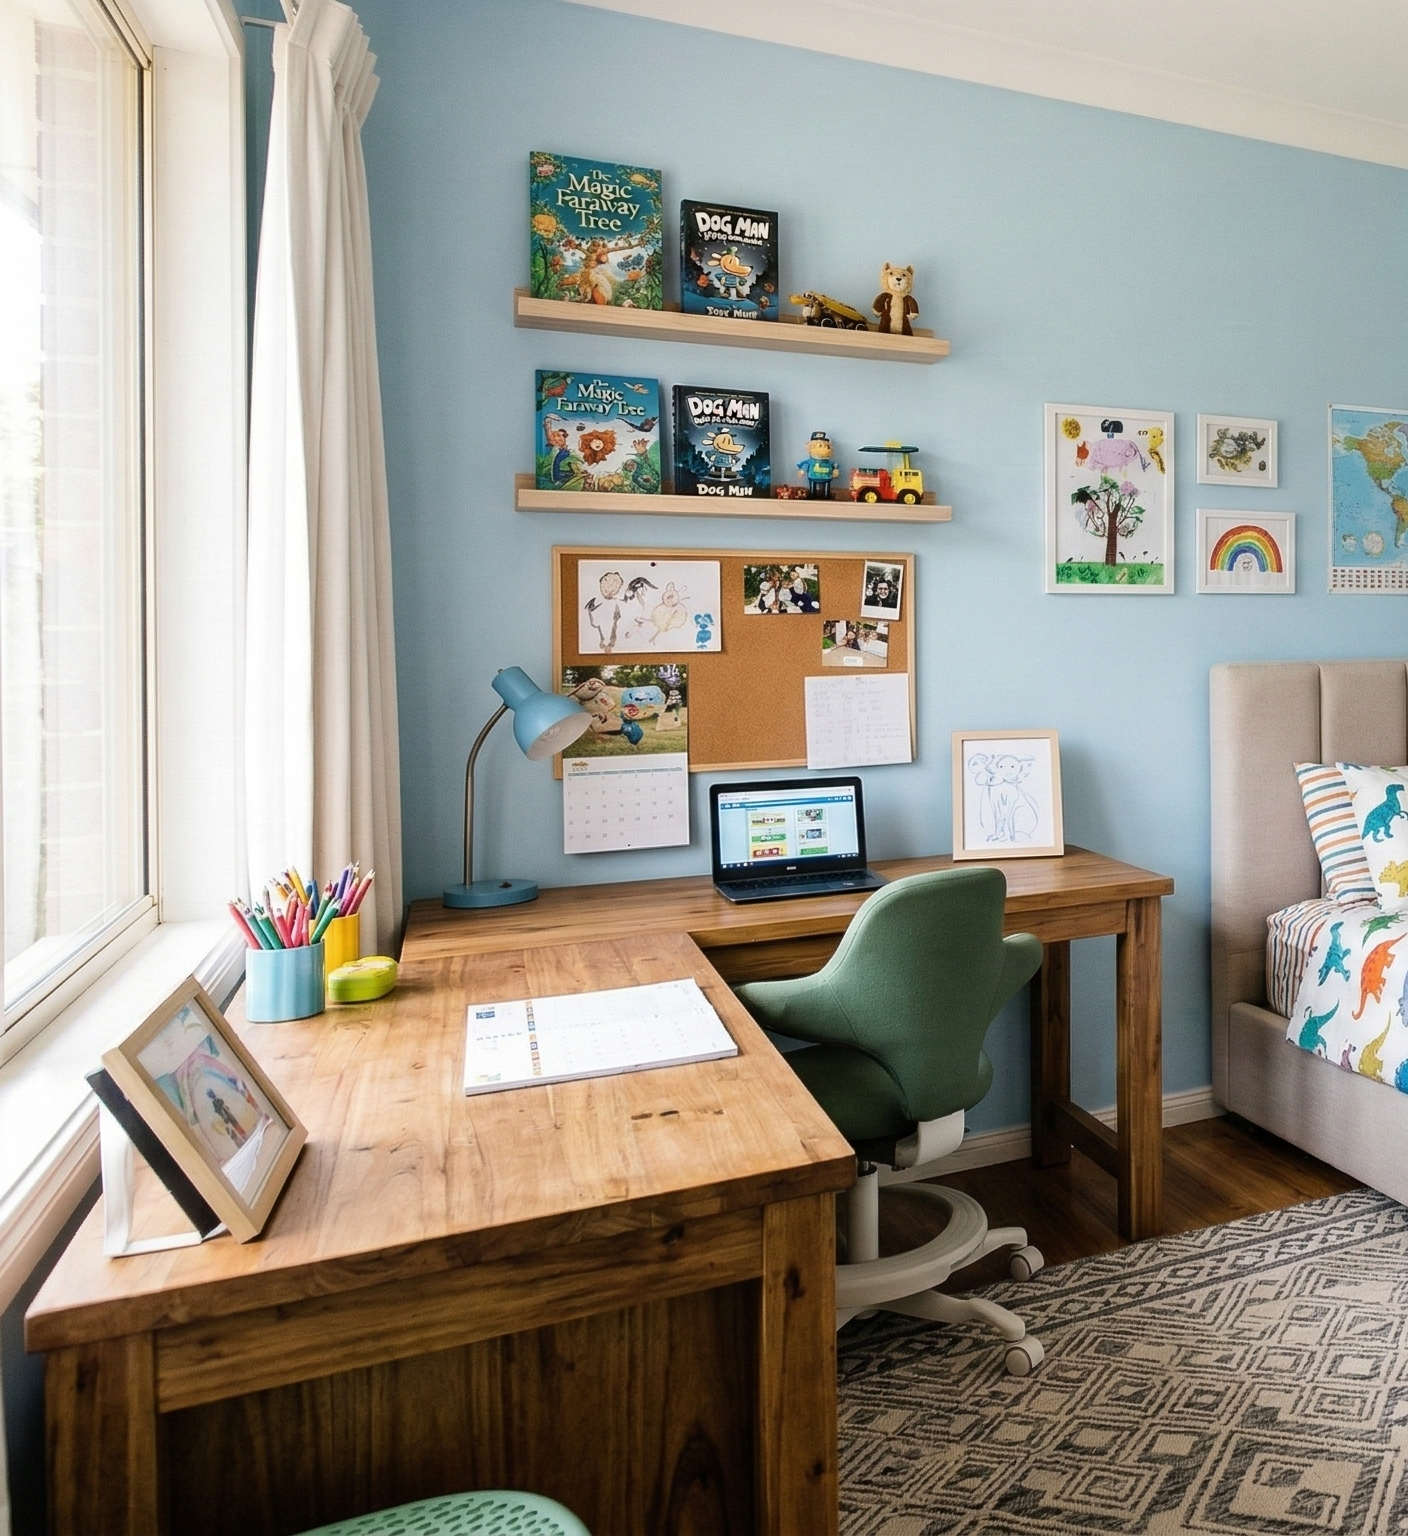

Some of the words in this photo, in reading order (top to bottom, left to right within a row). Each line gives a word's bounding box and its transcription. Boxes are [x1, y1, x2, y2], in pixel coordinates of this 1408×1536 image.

[568, 172, 633, 200] Magic
[556, 187, 640, 220] Faraway
[575, 208, 622, 232] Tree
[694, 211, 732, 235] DOG
[734, 216, 769, 240] MAN
[687, 396, 724, 417] DOG
[696, 483, 725, 497] DOG
